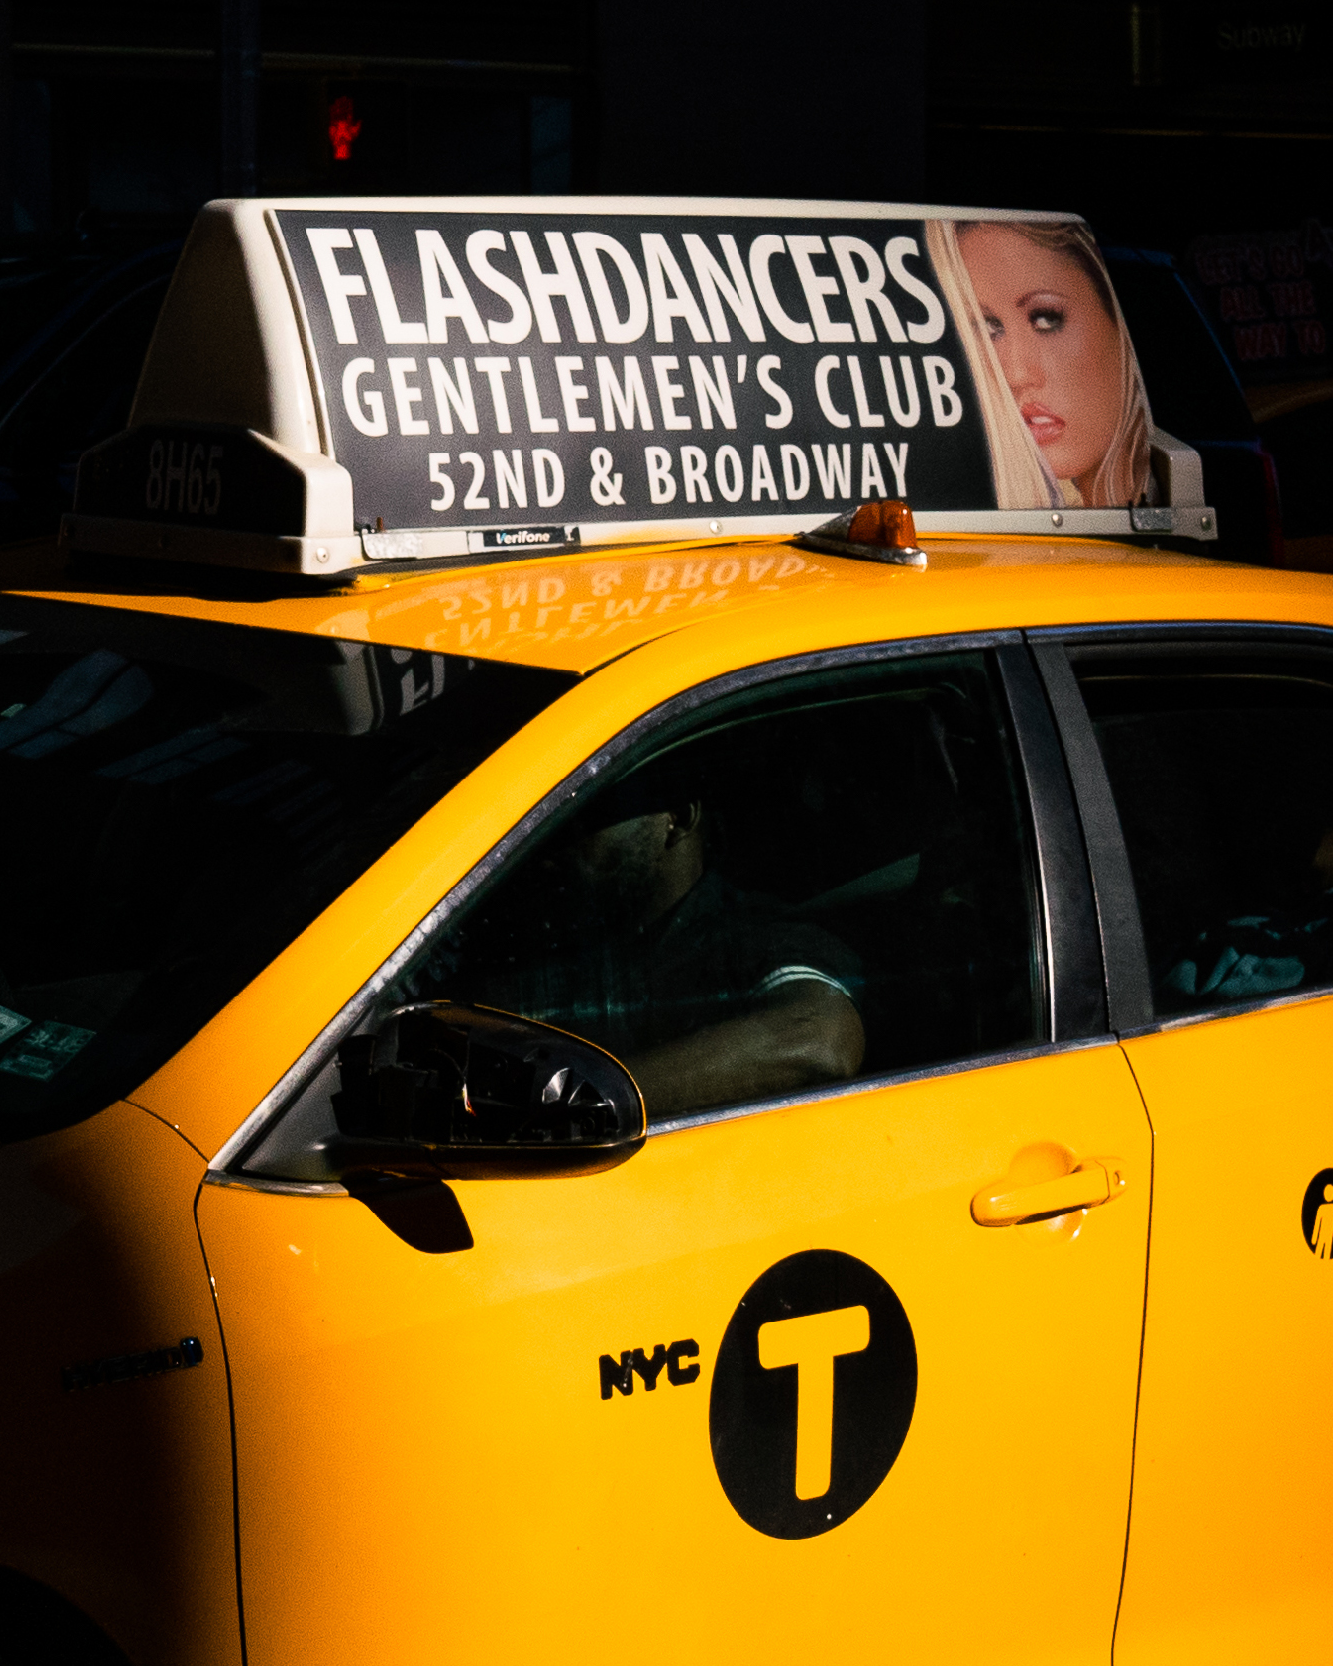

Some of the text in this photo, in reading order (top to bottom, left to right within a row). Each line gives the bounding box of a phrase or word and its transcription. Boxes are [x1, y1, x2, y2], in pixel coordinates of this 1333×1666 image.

[1217, 20, 1306, 54] Subway
[306, 227, 947, 346] FLASHDANCERS
[341, 354, 964, 438] GENTLEMEN'S CLUB
[145, 438, 223, 516] 8H65
[429, 442, 910, 511] 52ND & BROADWAY
[598, 1304, 871, 1501] NYC T
